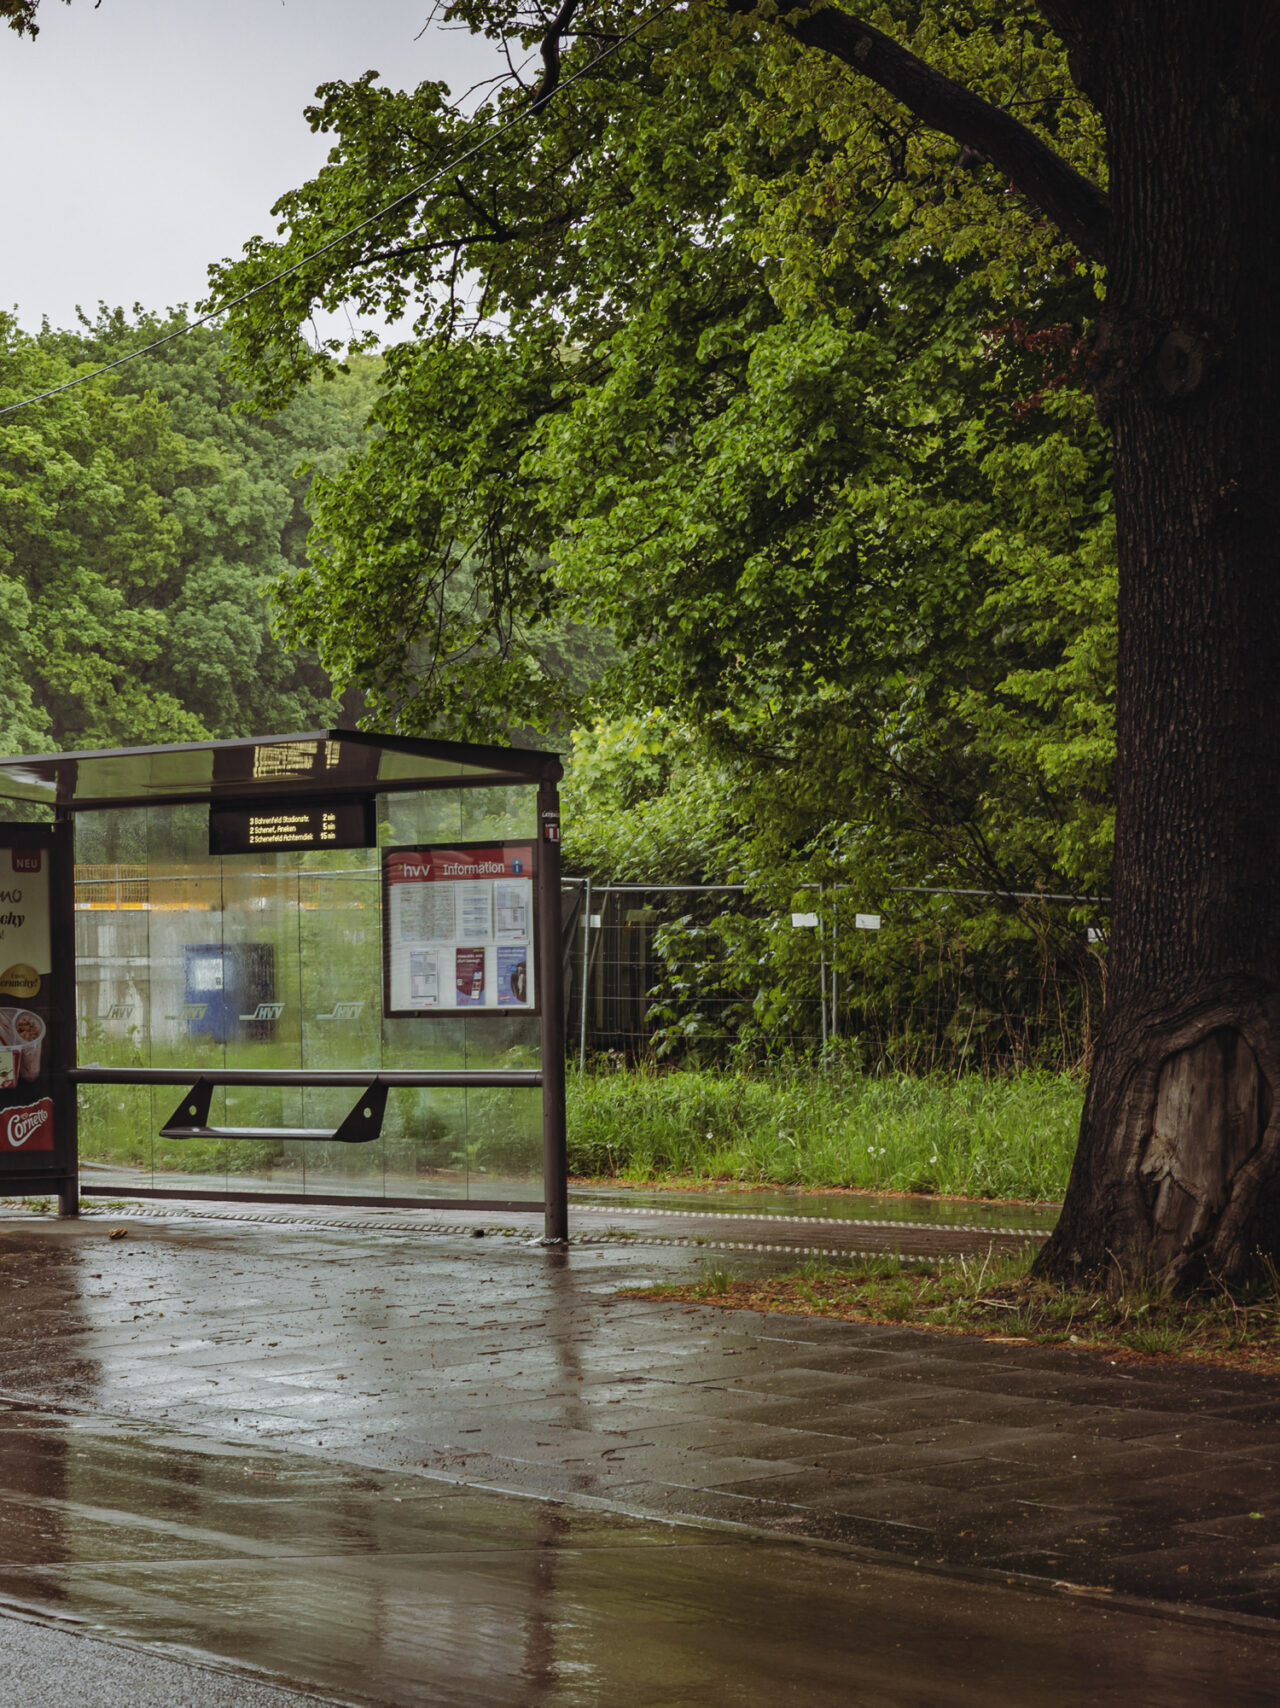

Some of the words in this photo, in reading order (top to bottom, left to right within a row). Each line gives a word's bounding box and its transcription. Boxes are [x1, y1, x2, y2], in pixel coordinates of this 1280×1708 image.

[249, 817, 255, 825] 3
[322, 813, 327, 821] 2
[249, 826, 255, 834] 2
[322, 823, 327, 831] 5
[249, 836, 255, 844] 2
[320, 832, 327, 840] 15
[16, 859, 38, 869] NEU
[403, 864, 430, 878] hvv
[443, 860, 505, 875] Information
[258, 1006, 283, 1019] HVV
[336, 1006, 362, 1019] HVV
[7, 1109, 48, 1147] Cornetto
